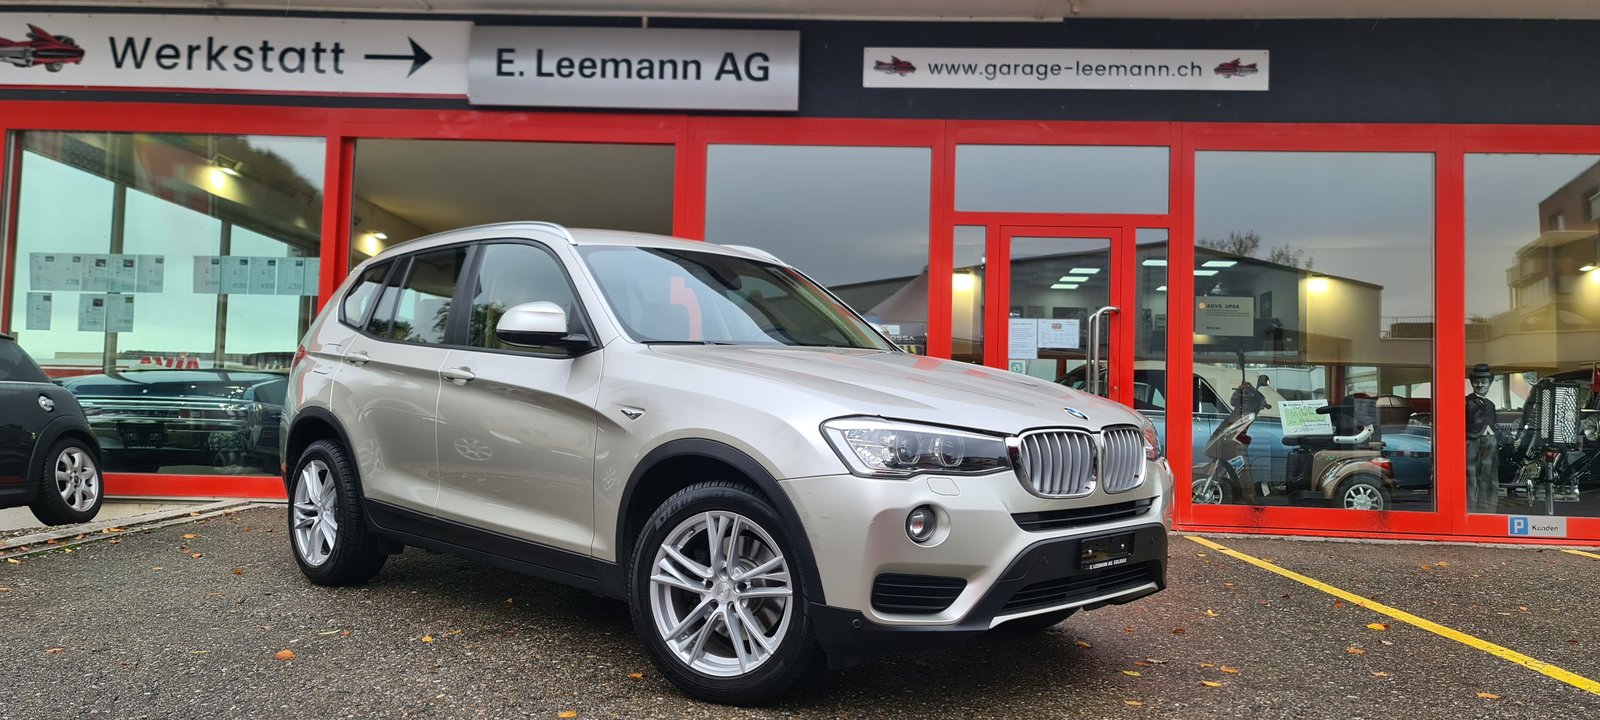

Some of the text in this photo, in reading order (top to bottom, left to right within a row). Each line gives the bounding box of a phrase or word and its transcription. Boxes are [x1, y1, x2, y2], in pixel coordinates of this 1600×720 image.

[108, 36, 346, 75] Werkstatt
[496, 48, 770, 82] E. Leemann AG
[928, 61, 1203, 81] www.garage-leemann.ch
[1514, 519, 1524, 534] P
